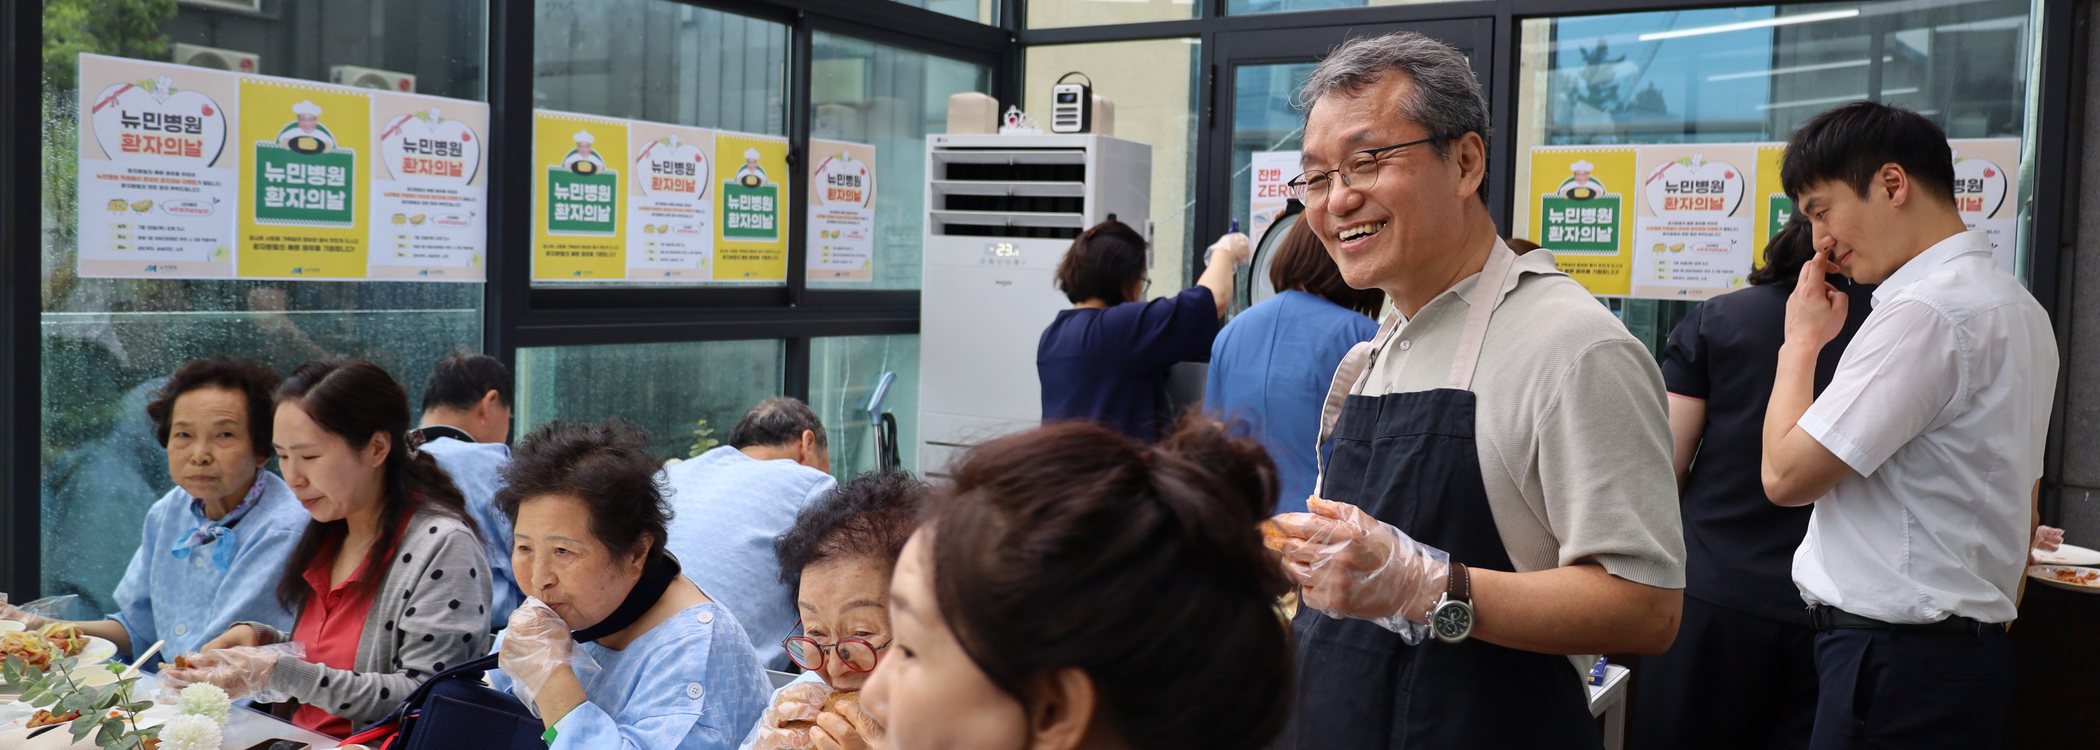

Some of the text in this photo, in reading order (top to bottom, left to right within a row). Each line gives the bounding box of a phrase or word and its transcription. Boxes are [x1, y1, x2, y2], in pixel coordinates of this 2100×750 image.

[121, 110, 202, 134] 뉴민병원
[121, 133, 203, 157] 환자의날
[403, 137, 462, 157] 뉴민병원
[264, 161, 345, 186] 뉴민병원
[403, 157, 463, 177] 환자의날
[652, 160, 696, 176] 뉴민병원
[1258, 169, 1281, 182] 잔반
[554, 182, 611, 202] 뉴민병원
[652, 176, 696, 193] 환자의날
[1664, 180, 1725, 194] 뉴민병원
[1954, 178, 1983, 193] 병원
[264, 186, 346, 210] 환자의날
[728, 194, 773, 211] 뉴민병원
[1664, 196, 1725, 211] 환자의날
[554, 203, 611, 222] 환자의날
[728, 212, 774, 229] 환자의날
[1548, 207, 1613, 224] 뉴민병원
[1548, 226, 1613, 242] 환자의날
